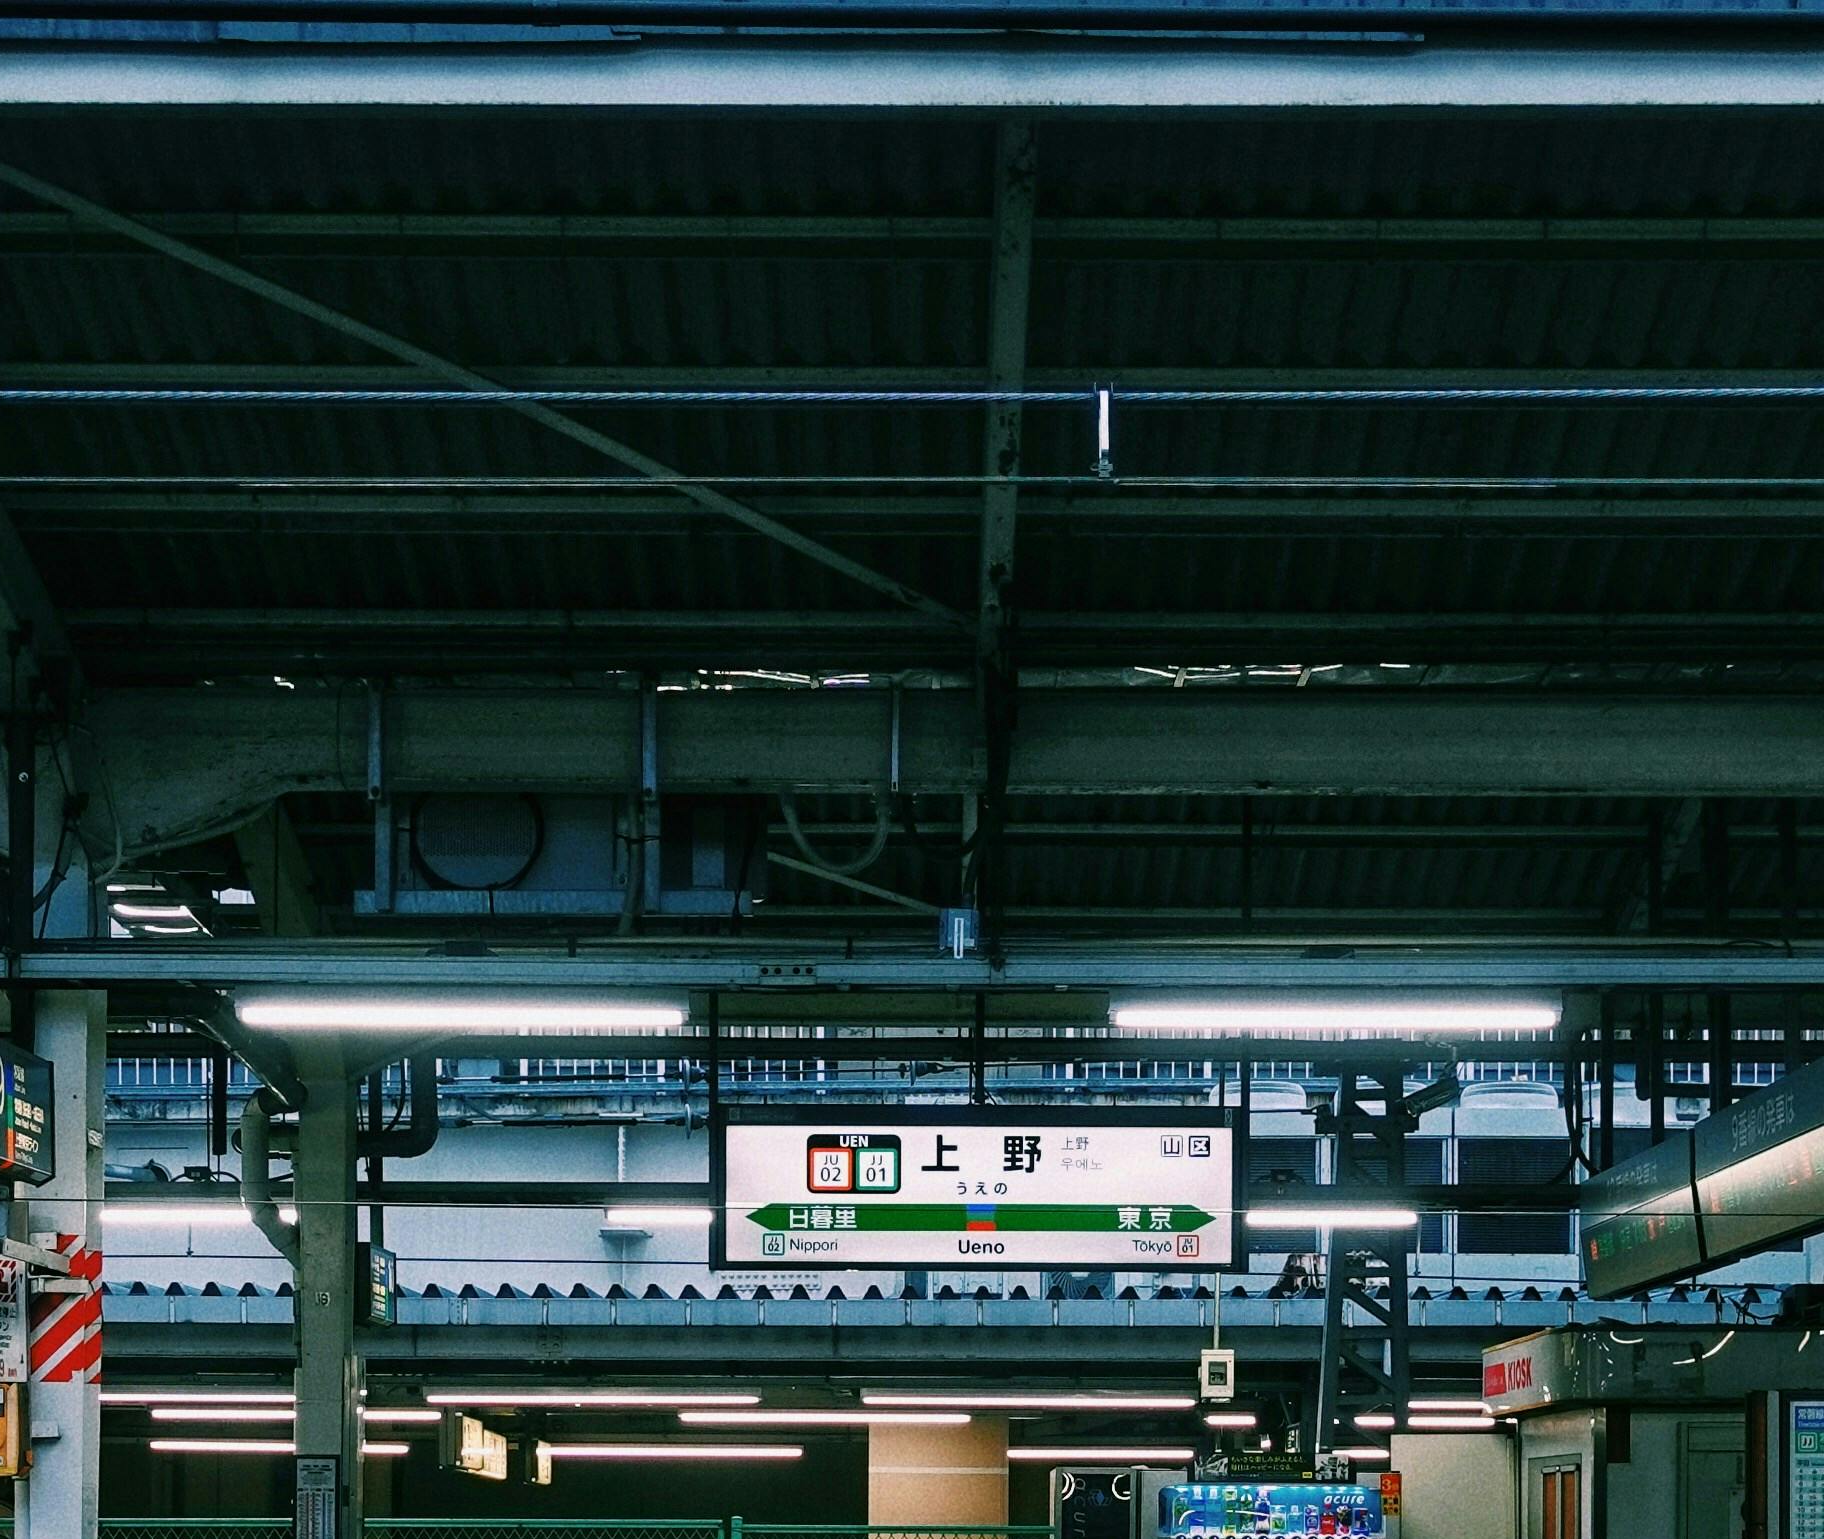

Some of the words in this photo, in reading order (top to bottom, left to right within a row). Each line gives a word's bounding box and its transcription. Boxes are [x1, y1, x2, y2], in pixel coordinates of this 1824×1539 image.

[840, 1135, 869, 1148] UEN
[1061, 1136, 1090, 1151] 上野
[1163, 1137, 1180, 1155] 山
[824, 1154, 839, 1166] JU
[871, 1154, 883, 1166] JJ
[921, 1134, 1042, 1173] 上野
[1061, 1158, 1104, 1171] 우에노
[820, 1168, 841, 1182] 02
[866, 1168, 887, 1182] 01
[957, 1182, 1008, 1196] うえの
[789, 1206, 857, 1229] 日暮里
[1117, 1206, 1173, 1230] 東京
[767, 1242, 780, 1252] 02
[789, 1239, 838, 1256] Nippori
[958, 1240, 1005, 1254] Ueno
[1132, 1238, 1172, 1256] Tōkyō
[1182, 1244, 1194, 1254] 01
[1508, 1356, 1533, 1391] KIOSK
[1324, 1494, 1366, 1506] acure
